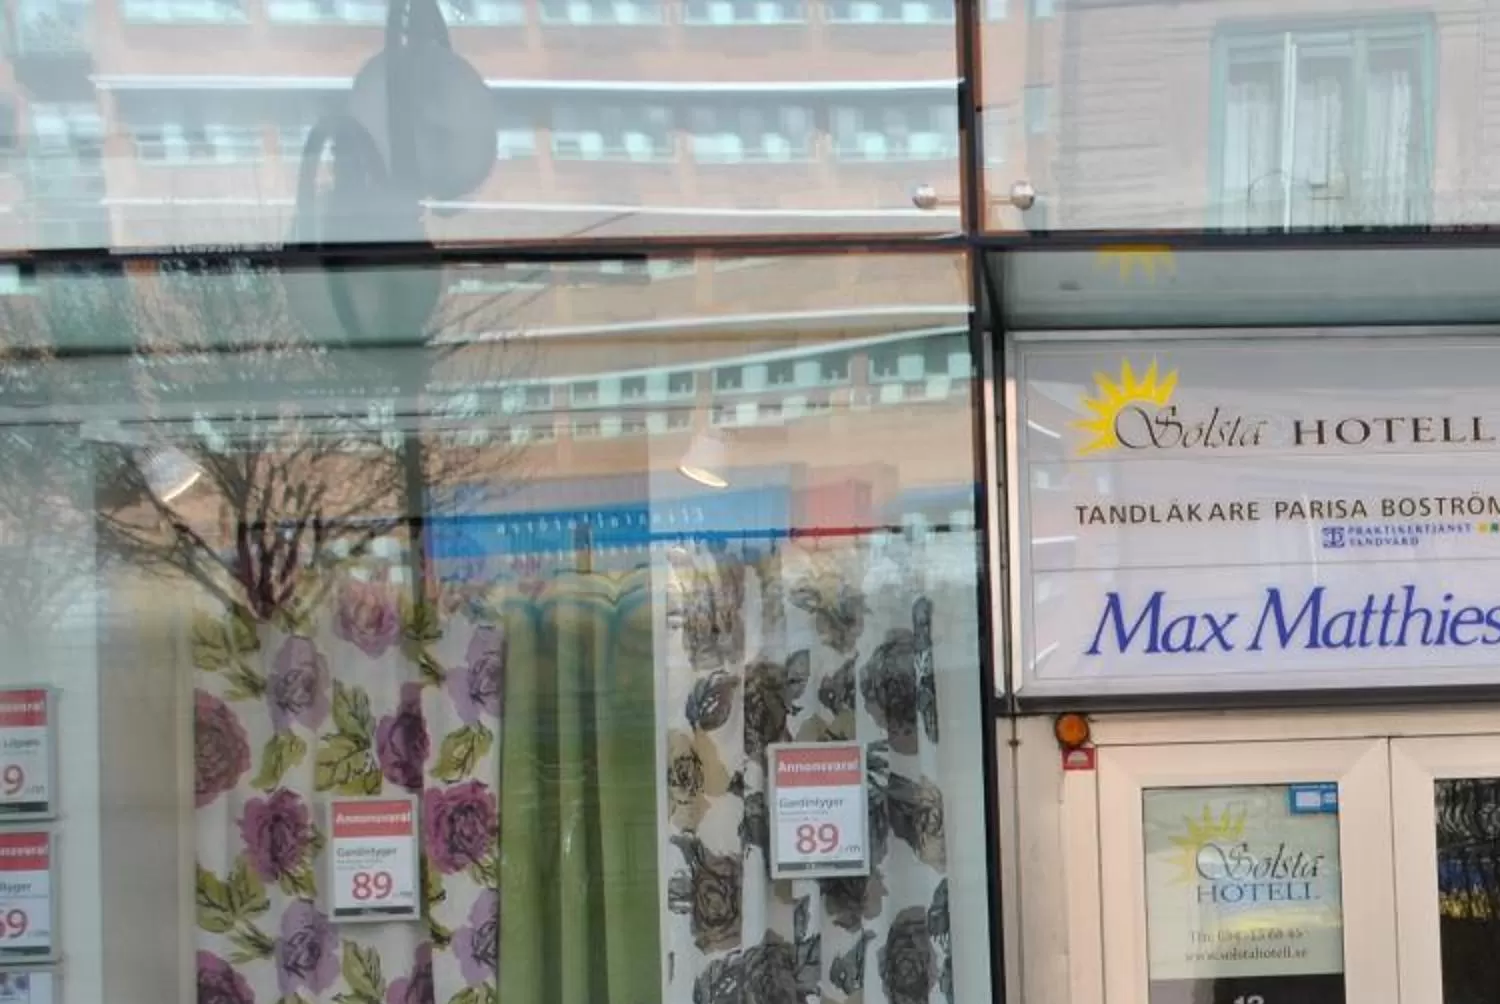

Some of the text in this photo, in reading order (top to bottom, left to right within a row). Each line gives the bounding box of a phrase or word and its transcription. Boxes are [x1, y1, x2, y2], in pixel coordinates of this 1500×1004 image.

[1113, 401, 1497, 449] Solsta HOTELL
[1274, 497, 1368, 521] PARISA
[1085, 591, 1240, 656] Max
[795, 823, 839, 854] 89
[1195, 841, 1325, 881] Solsta
[351, 871, 393, 901] 89
[1196, 881, 1322, 904] HOTELL
